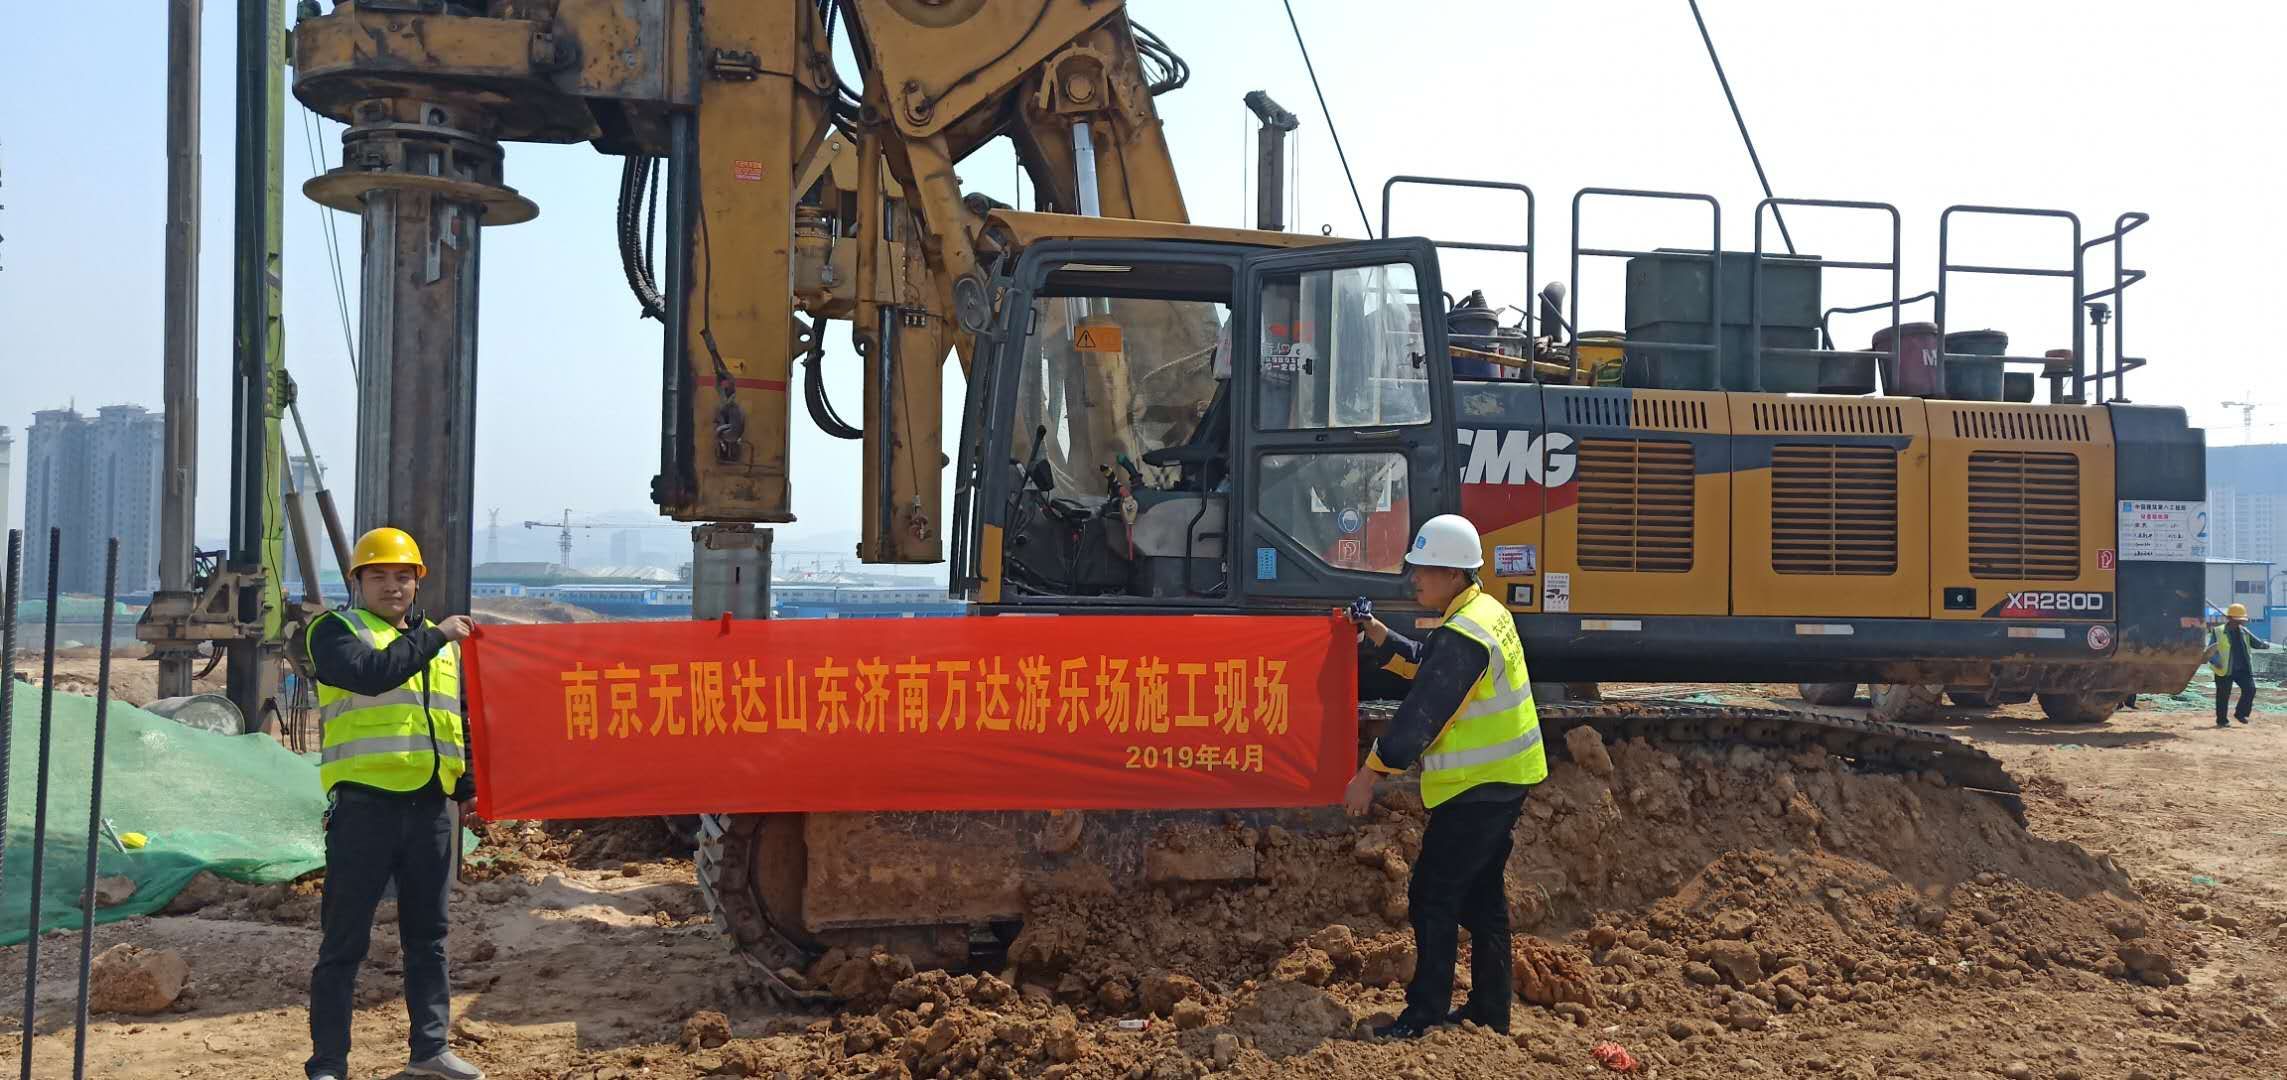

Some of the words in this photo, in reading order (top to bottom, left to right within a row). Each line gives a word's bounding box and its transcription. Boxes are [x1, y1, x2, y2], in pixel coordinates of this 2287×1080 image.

[2006, 592, 2103, 611] XR280D
[561, 655, 1289, 741] 南京无限达山东济南万达游乐场施工现场
[1125, 744, 1264, 773] 2019年4月
